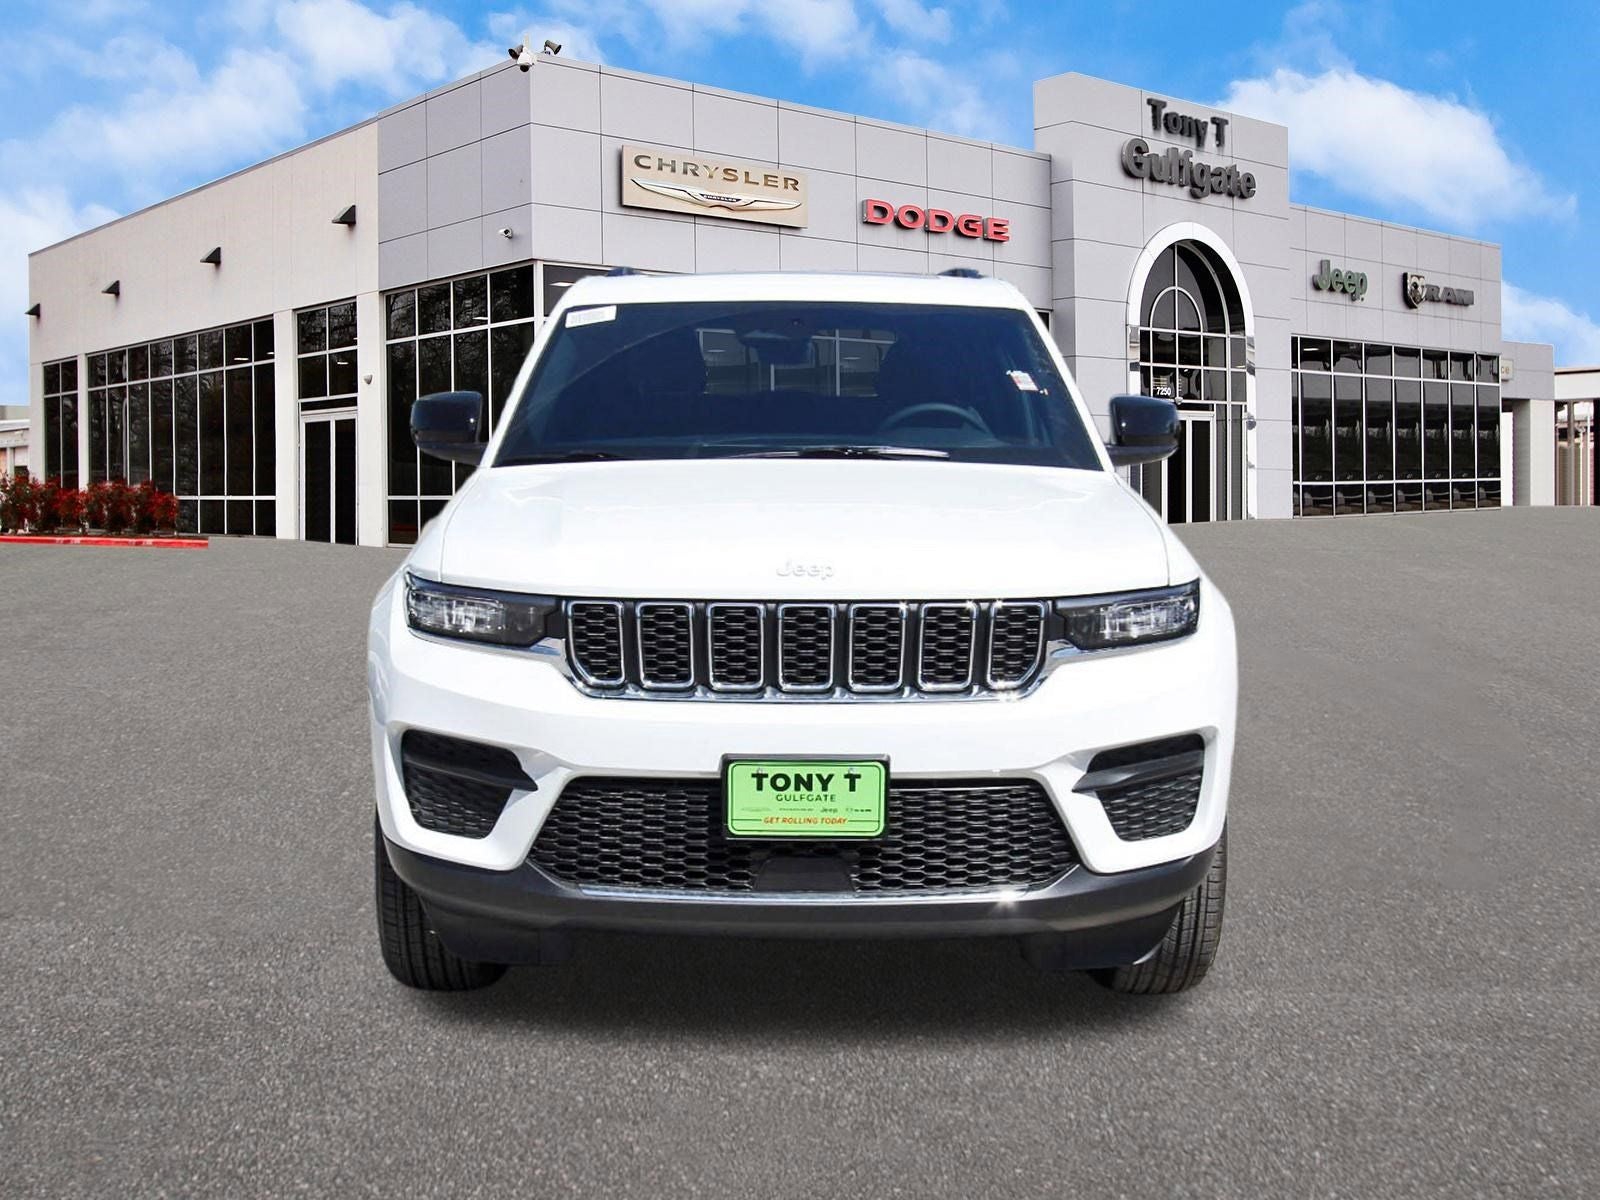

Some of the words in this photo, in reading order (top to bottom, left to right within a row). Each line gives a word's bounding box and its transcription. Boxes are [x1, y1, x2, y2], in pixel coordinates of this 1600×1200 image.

[1147, 97, 1208, 148] Tony
[1210, 116, 1229, 148] T
[633, 153, 800, 192] CHRYSLER
[1121, 137, 1257, 199] Gulfgate
[862, 198, 1011, 242] DODGE
[1313, 259, 1367, 301] Jeep
[1424, 283, 1474, 306] RAM
[1156, 386, 1172, 396] 7250
[776, 557, 833, 581] Jeep
[751, 773, 834, 792] TONY
[844, 773, 861, 792] T
[775, 794, 837, 802] GULFGATE
[781, 817, 818, 825] ROLLING
[820, 817, 847, 825] TODAY
